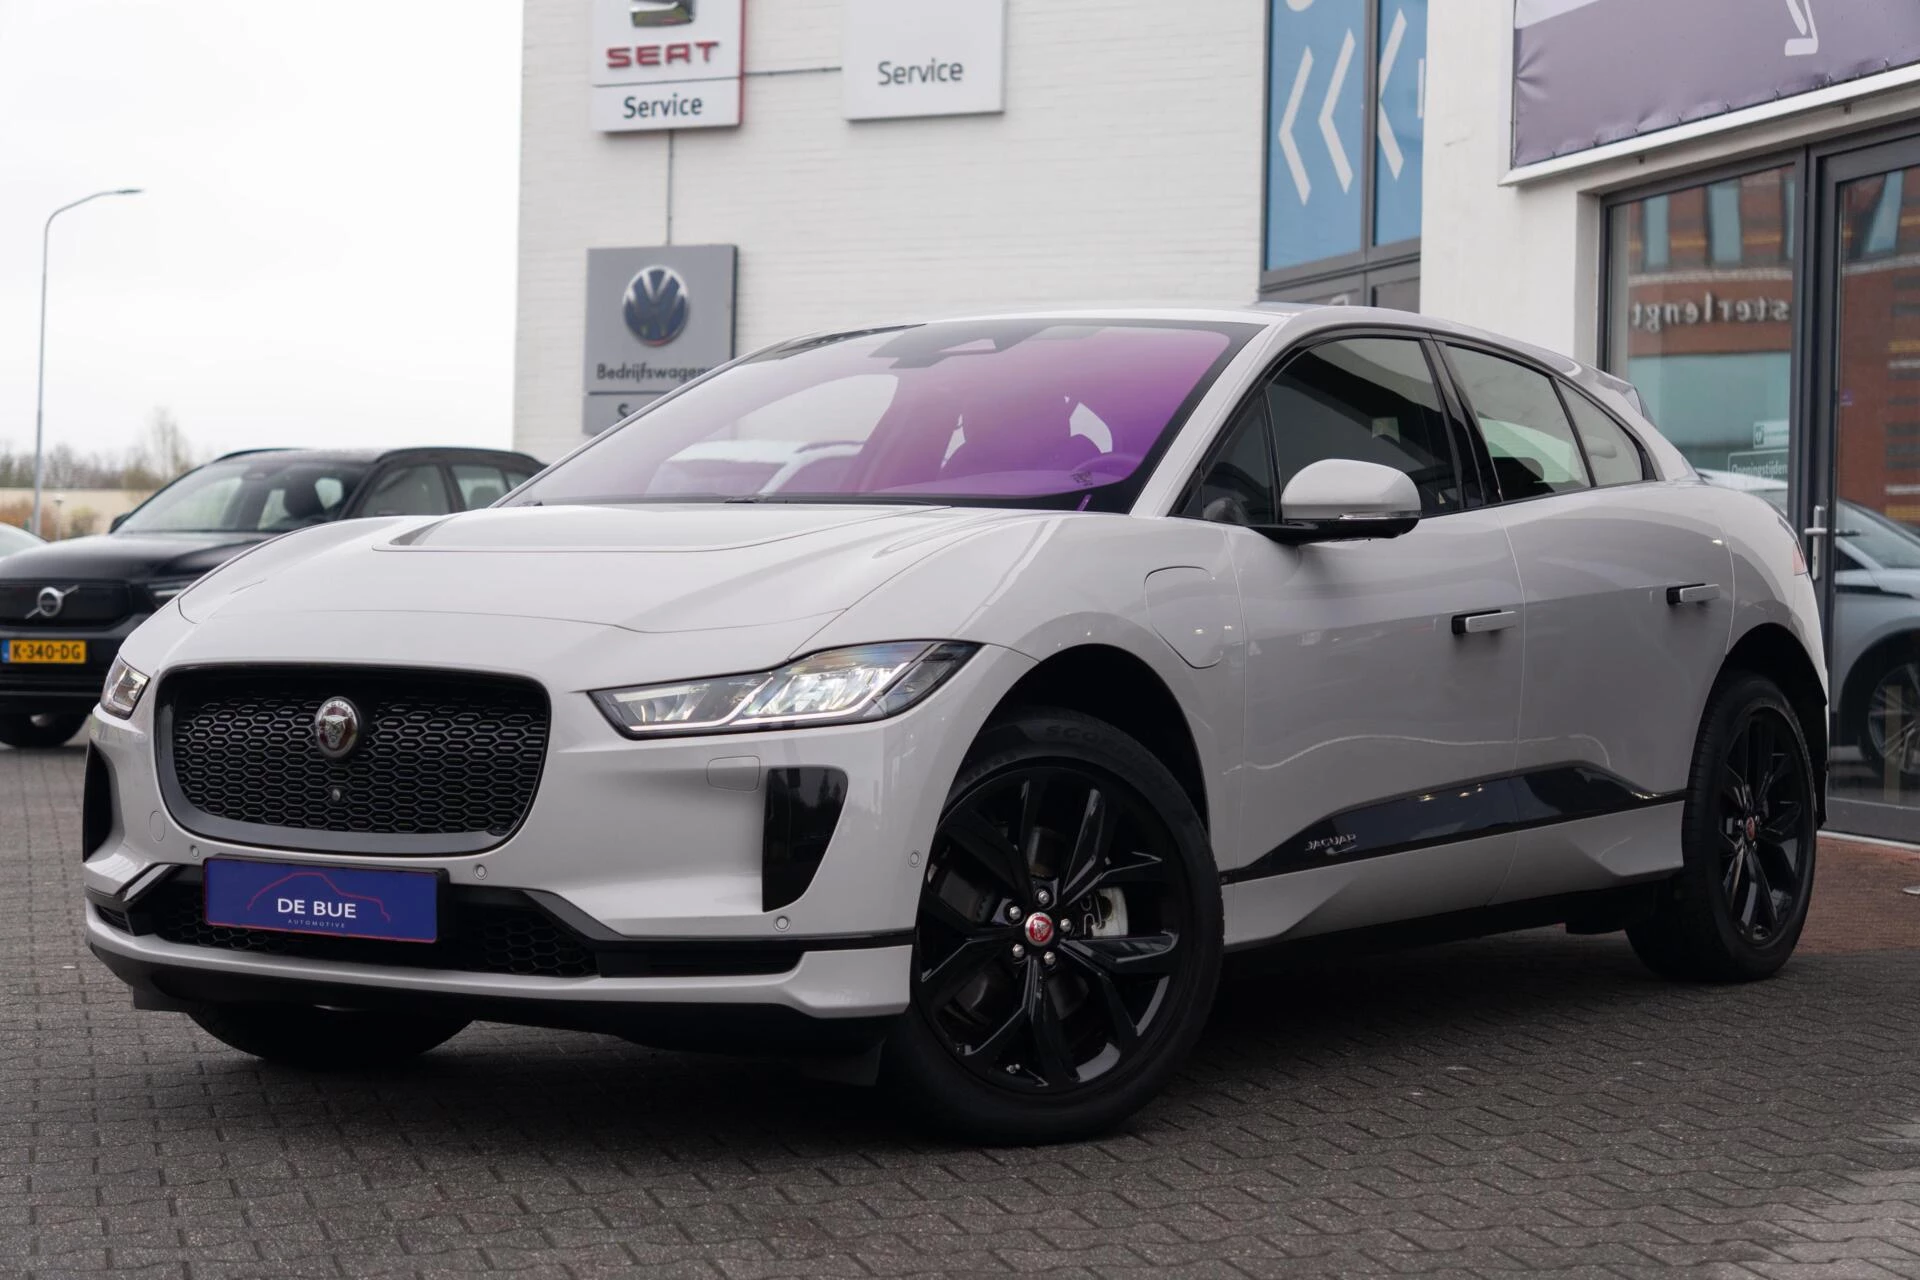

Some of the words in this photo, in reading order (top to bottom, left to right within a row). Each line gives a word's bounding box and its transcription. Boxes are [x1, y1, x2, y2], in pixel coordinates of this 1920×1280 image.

[606, 41, 719, 69] SEAT
[879, 58, 964, 86] Service
[623, 93, 703, 119] Service
[12, 644, 82, 660] K-340-DG
[277, 898, 306, 915] DE
[313, 901, 357, 918] BUE
[287, 919, 346, 929] AUTOMOTIVE
